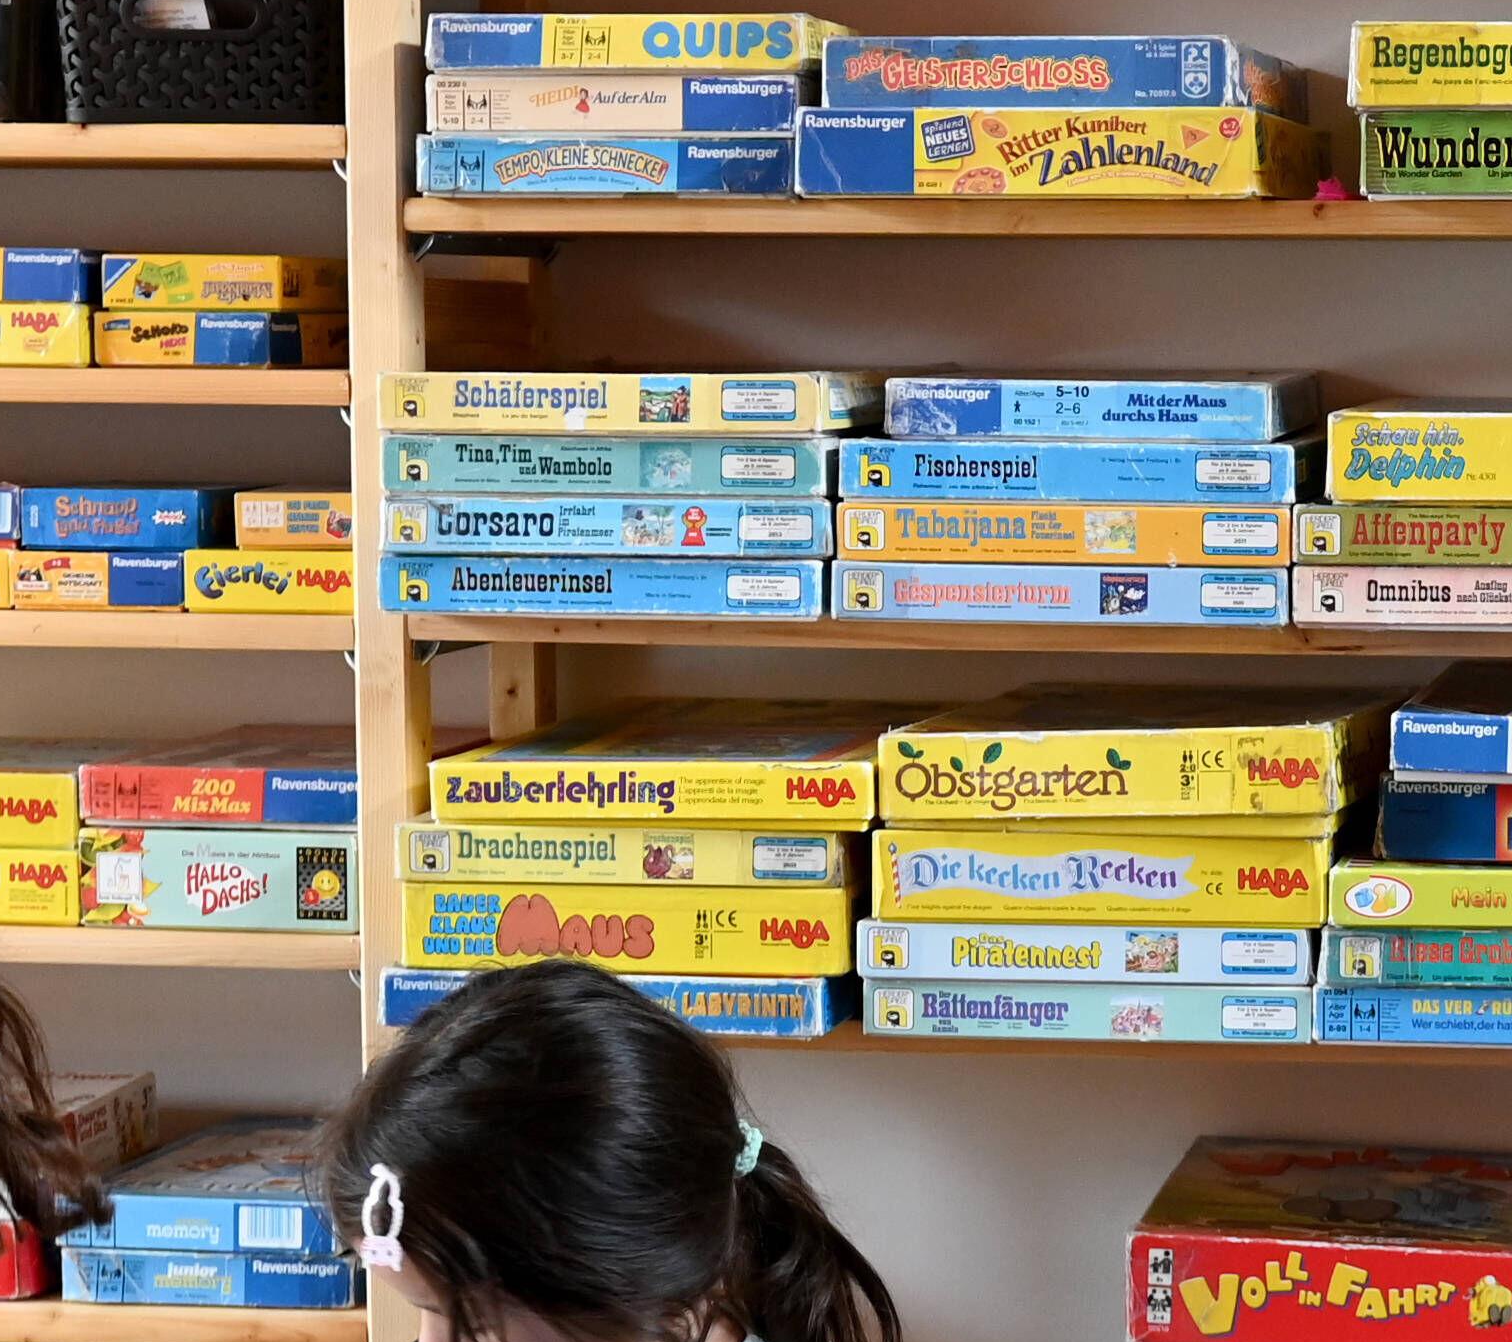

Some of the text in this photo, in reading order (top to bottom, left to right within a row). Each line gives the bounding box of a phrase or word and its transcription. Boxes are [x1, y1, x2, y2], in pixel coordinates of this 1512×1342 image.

[440, 21, 532, 33] Ravensburger
[643, 21, 793, 59] QUIPS
[925, 131, 967, 147] NEUES
[1001, 116, 1147, 163] Ritter Kunibert
[1036, 140, 1217, 186] Zahlenland
[455, 381, 608, 413] Schäferspiel
[1126, 394, 1227, 409] Mit der Maus
[1103, 409, 1197, 422] durchs Haus
[519, 456, 612, 476] und Wambolo
[914, 454, 1038, 477] Fischerspiel
[1346, 448, 1464, 486] Delphin
[1351, 515, 1506, 554] Affenparty
[194, 562, 291, 597] Eierlei
[452, 567, 612, 593] Abenteuerinsel
[1367, 579, 1452, 604] Omnibus
[1402, 721, 1498, 737] Ravensburger
[447, 773, 675, 813] Zauberlehrling
[787, 777, 856, 807] HABA
[896, 762, 1128, 810] Obstgarten
[457, 833, 616, 861] Drachenspiel
[187, 865, 243, 899] HALLO
[1451, 887, 1508, 908] Mein
[952, 939, 1102, 969] Piratennest
[1300, 1292, 1321, 1306] IN
